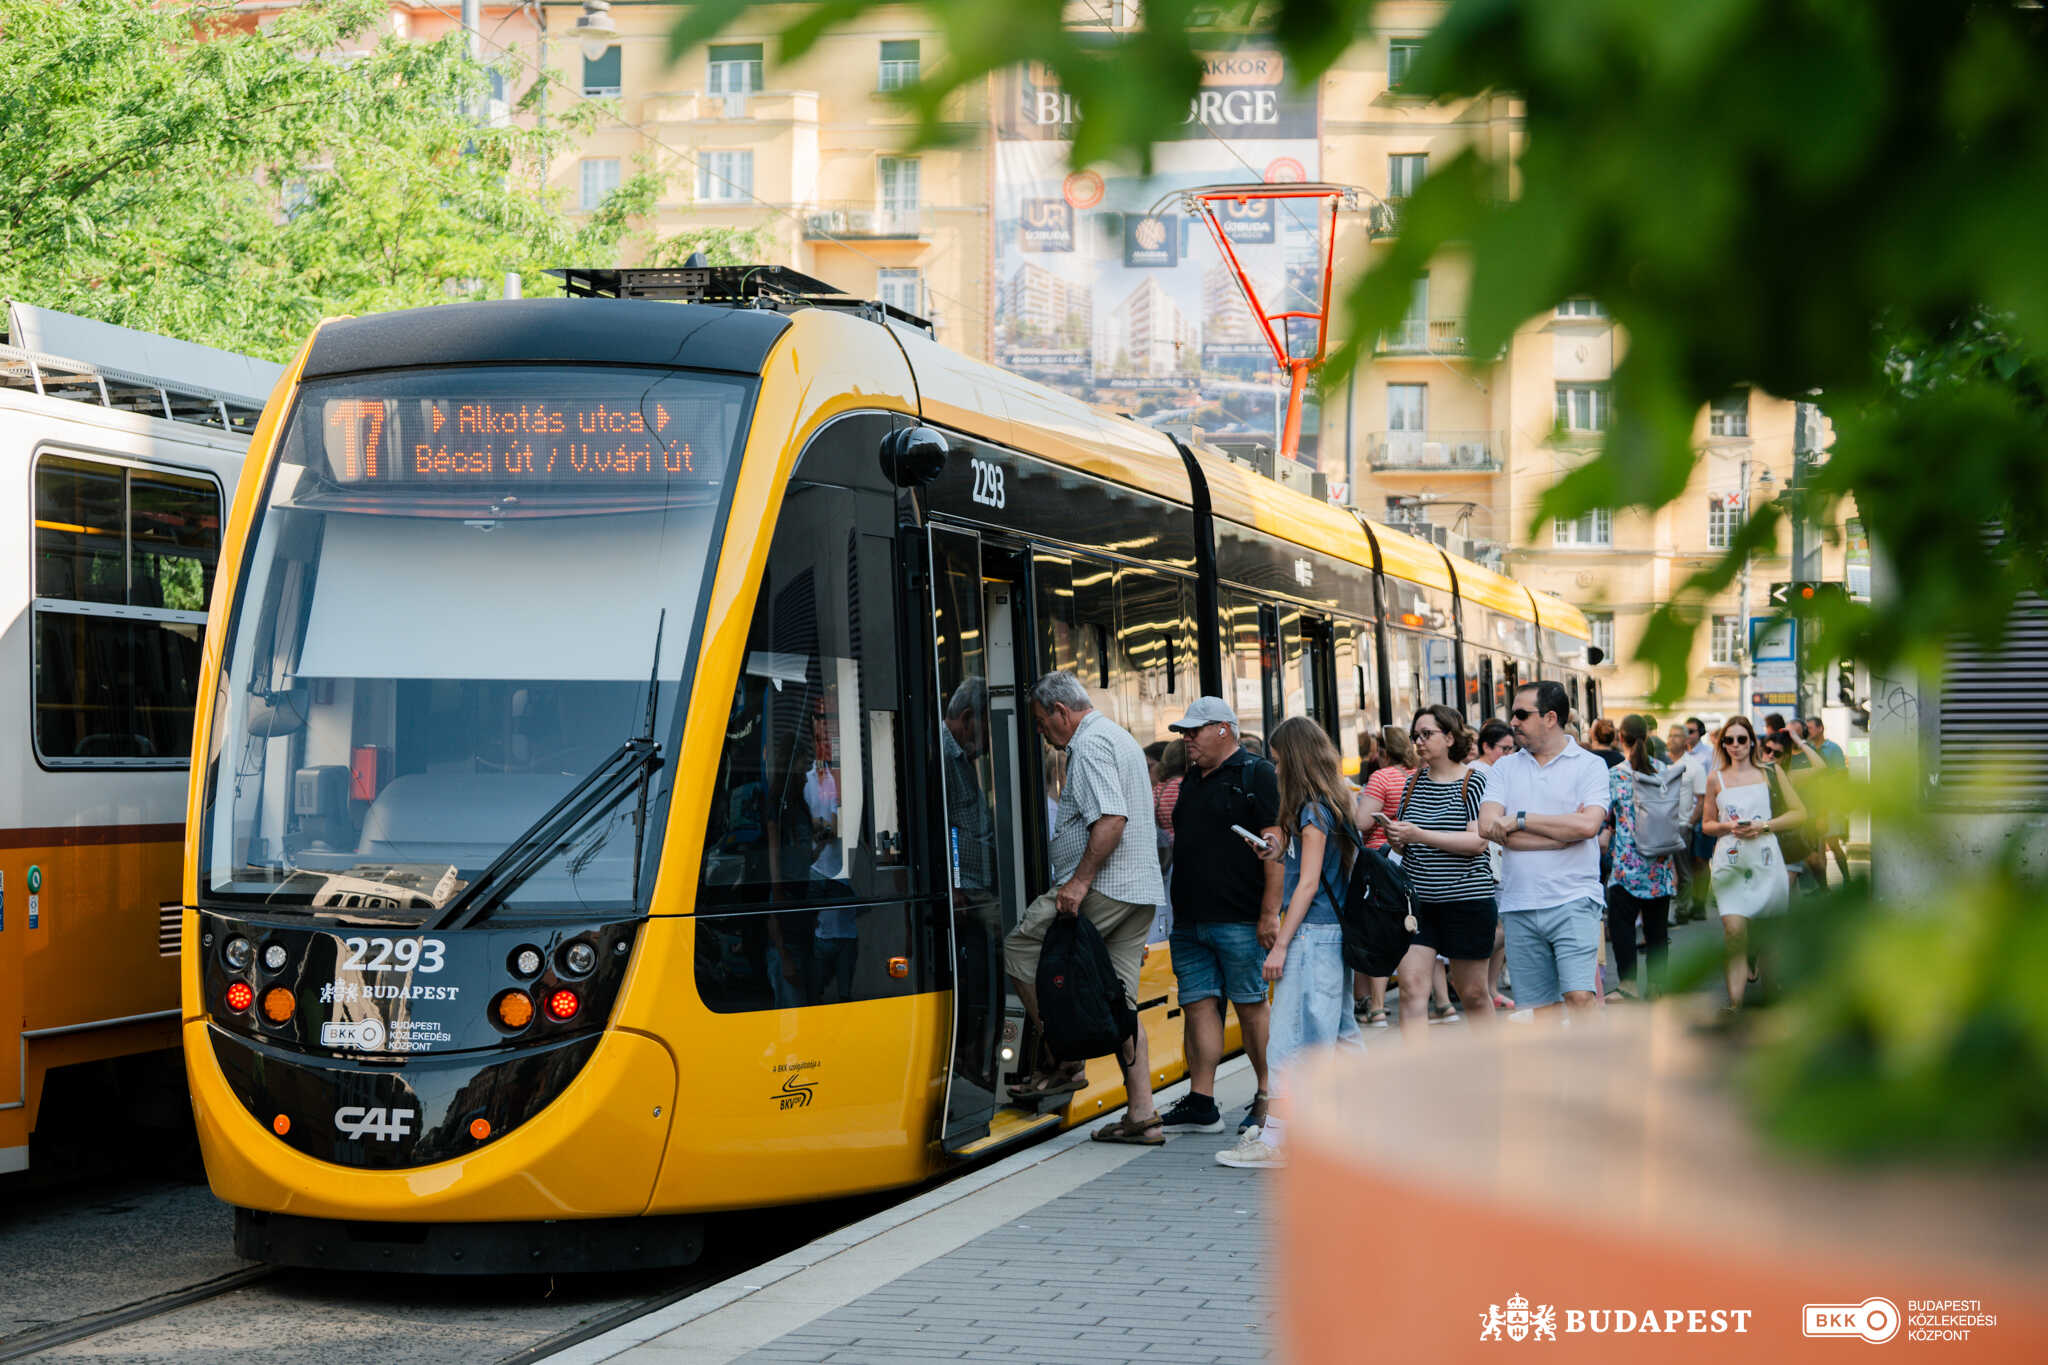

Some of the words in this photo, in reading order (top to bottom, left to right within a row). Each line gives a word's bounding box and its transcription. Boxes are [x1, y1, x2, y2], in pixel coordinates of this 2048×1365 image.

[459, 404, 566, 433] Alkotás
[578, 404, 644, 433] utca
[330, 402, 384, 478] 17
[415, 443, 494, 473] Bécsi
[505, 440, 533, 473] út
[664, 440, 693, 472] út
[970, 458, 1006, 509] 2293
[342, 937, 446, 974] 2293
[361, 985, 459, 1001] BUDAPEST
[330, 1028, 357, 1040] BKK
[390, 1032, 452, 1042] KÖZLEKEDÉSI
[391, 1021, 441, 1031] BUDAPESTI
[388, 1042, 433, 1051] KÖZPONT
[334, 1106, 416, 1143] CAF
